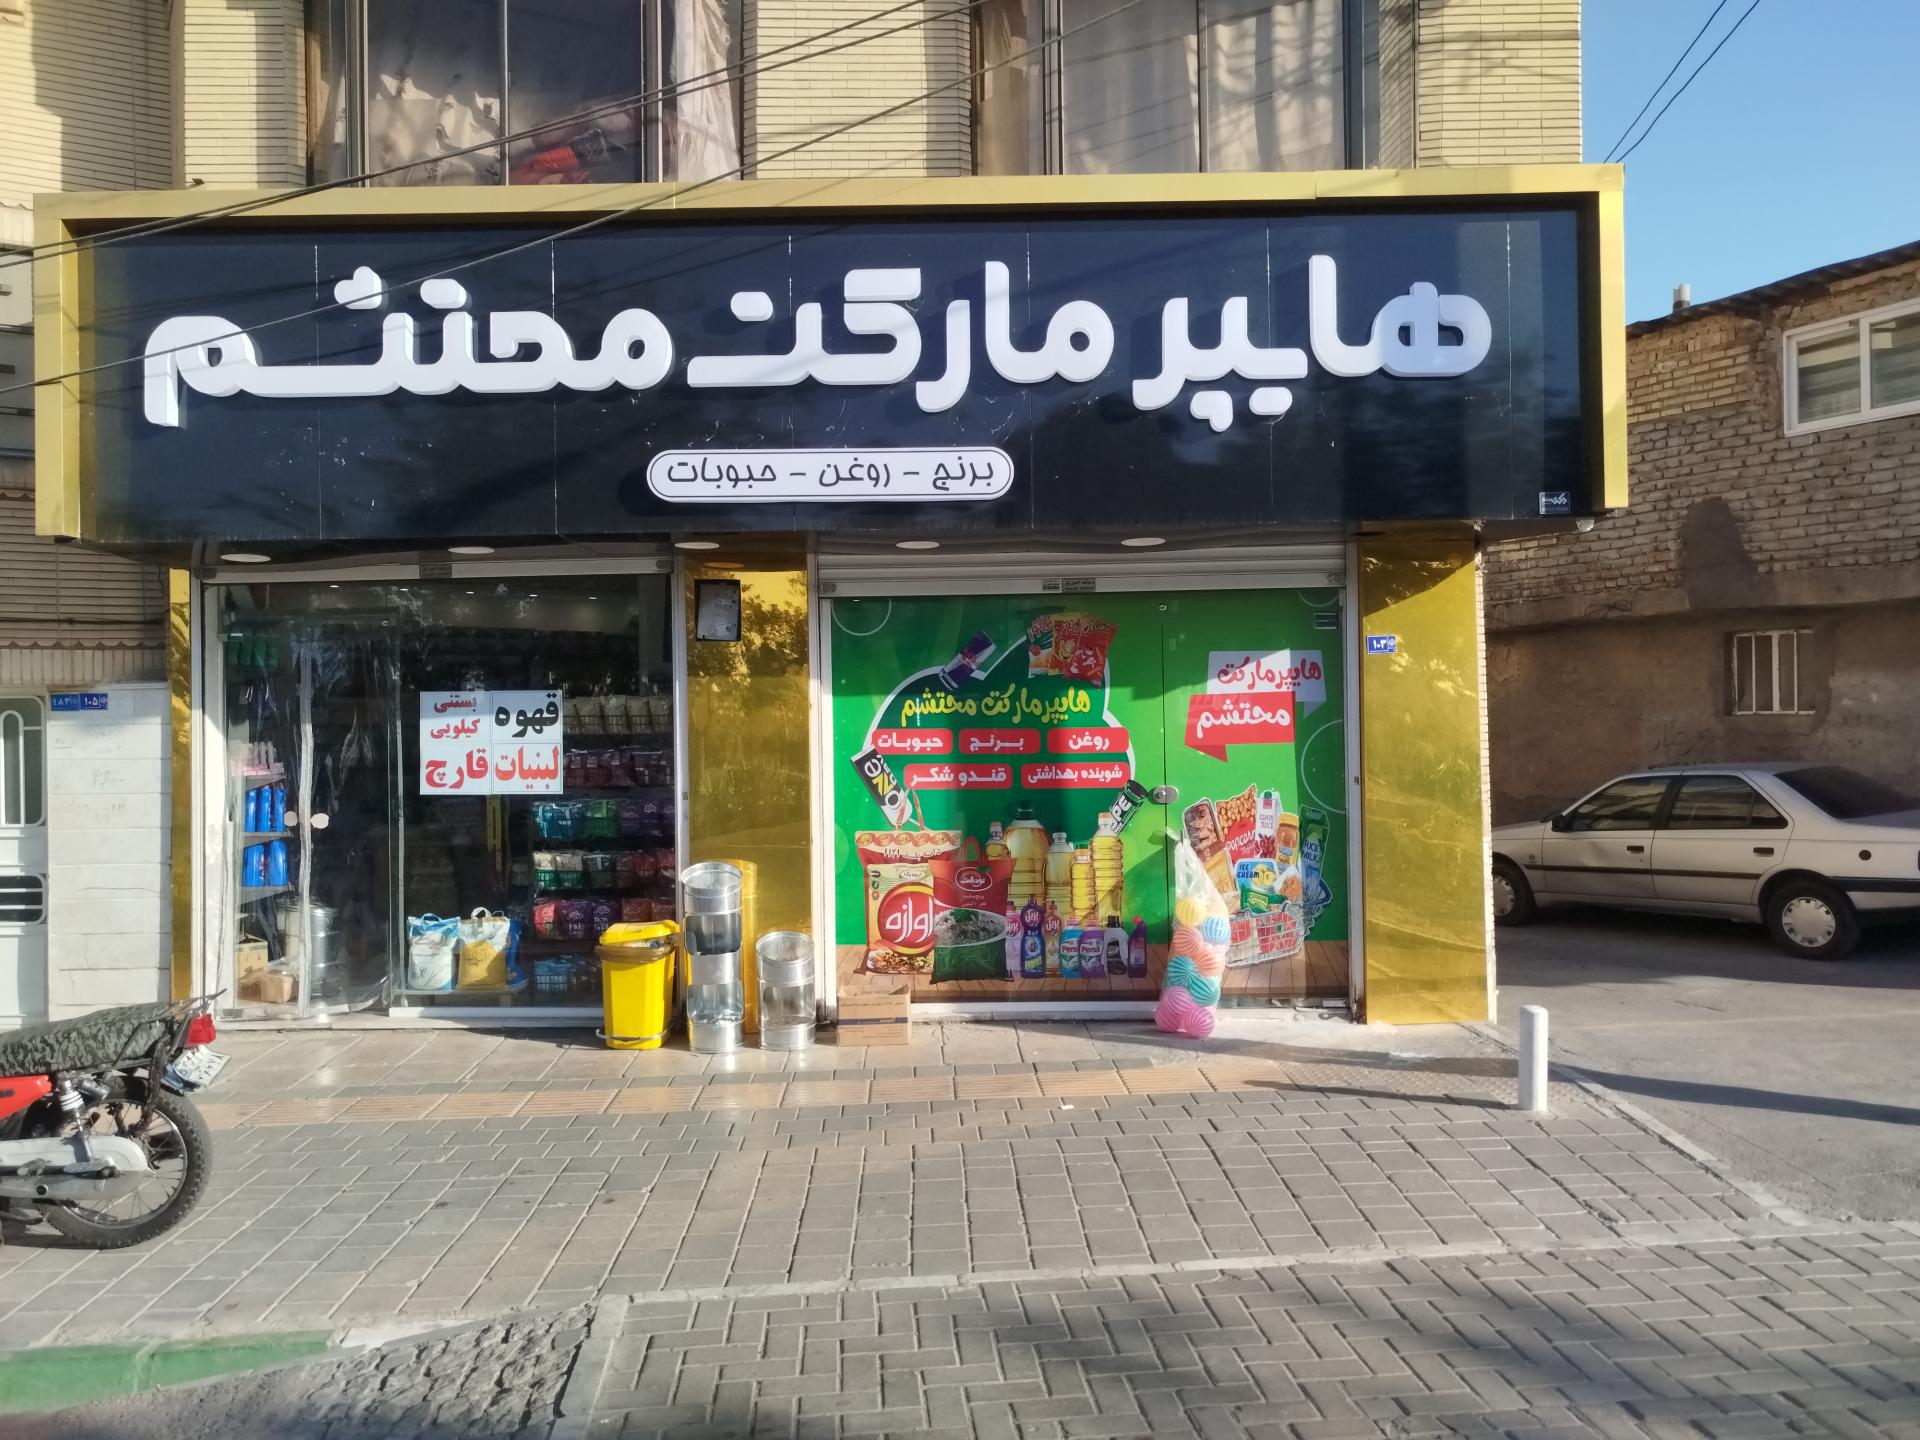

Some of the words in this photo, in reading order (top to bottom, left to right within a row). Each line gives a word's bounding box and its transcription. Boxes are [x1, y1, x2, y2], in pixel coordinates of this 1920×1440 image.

[687, 261, 1115, 412] مارکت
[1132, 255, 1492, 432] هایپر
[666, 457, 778, 489] حبوبات
[818, 457, 891, 488] روغن
[931, 456, 995, 491] برنج
[433, 694, 478, 714] بستنی
[494, 692, 560, 738] قهوه
[901, 687, 977, 728] محتشم
[1196, 699, 1291, 739] محتشم
[430, 718, 480, 739] کیلویی
[877, 733, 944, 752] حبوبات
[969, 734, 1025, 751] برنج
[1068, 731, 1110, 751] روغن
[425, 748, 489, 789] قارچ
[494, 745, 560, 790] لبنیات
[910, 767, 955, 786] شکر
[1027, 765, 1079, 784] بهداشتی
[1081, 764, 1123, 783] شوینده
